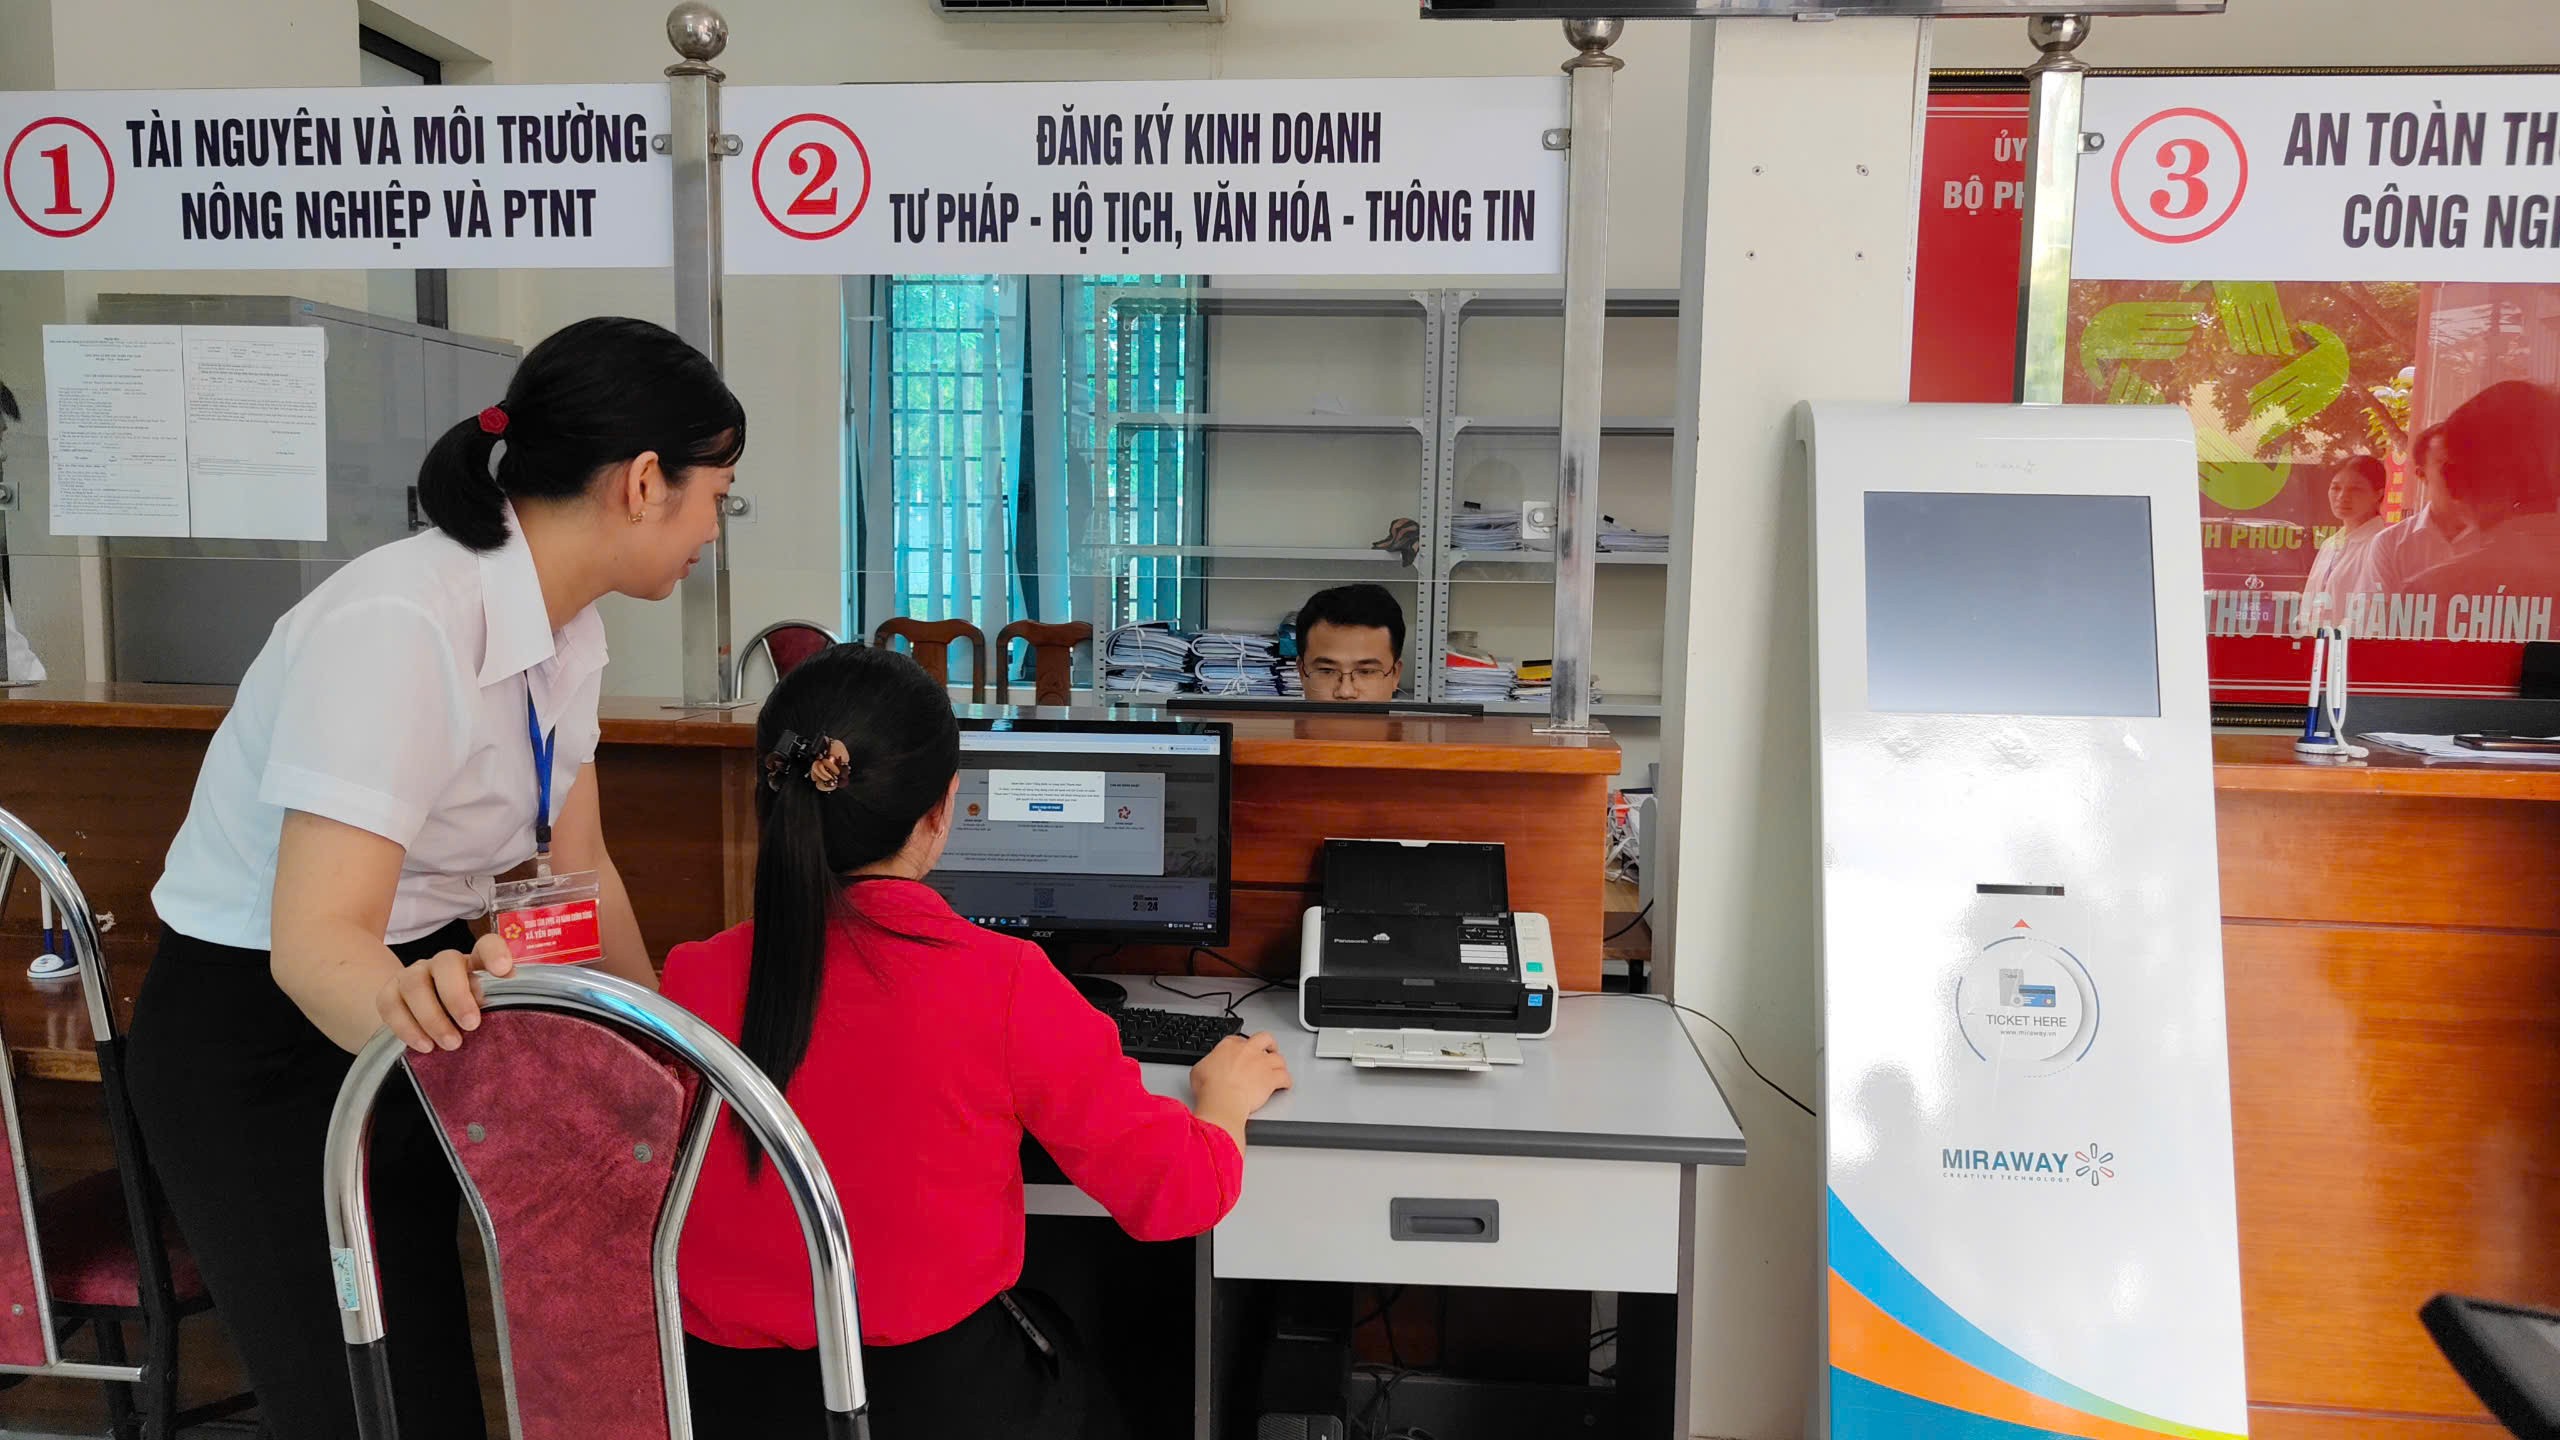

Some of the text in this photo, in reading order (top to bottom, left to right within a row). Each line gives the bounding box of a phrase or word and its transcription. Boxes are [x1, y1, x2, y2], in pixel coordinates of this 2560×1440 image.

[126, 102, 647, 167] TÀI NGUYÊN VÀ MÔI TRƯỜNG
[1037, 103, 1381, 165] ĐĂNG KÝ KINH DOANH
[1994, 129, 2027, 161] ỦY
[2284, 100, 2560, 166] AN TOÀN TH
[41, 144, 81, 214] 1
[787, 143, 837, 215] 2
[1944, 175, 1983, 215] BỘ
[2150, 139, 2209, 219] 3
[182, 179, 596, 249] NÔNG NGHIỆP VÀ PTNT
[890, 182, 931, 243] TƯ
[938, 182, 1019, 242] PHÁP
[1053, 181, 1092, 254] HỘ
[1104, 192, 1181, 254] TỊCH,
[1194, 180, 1256, 242] VĂN
[1269, 180, 1331, 242] HÓA
[1366, 179, 1471, 242] THÔNG
[1484, 190, 1535, 241] TIN
[2343, 183, 2468, 248] CÔNG
[2344, 582, 2437, 641] HÀNH
[2446, 585, 2553, 643] CHÍNH
[1032, 930, 1055, 938] acer
[1986, 1014, 2068, 1028] TICKET HERE
[1942, 1148, 2069, 1173] MIRAWAY
[2001, 1175, 2070, 1183] TECHNOLOGY
